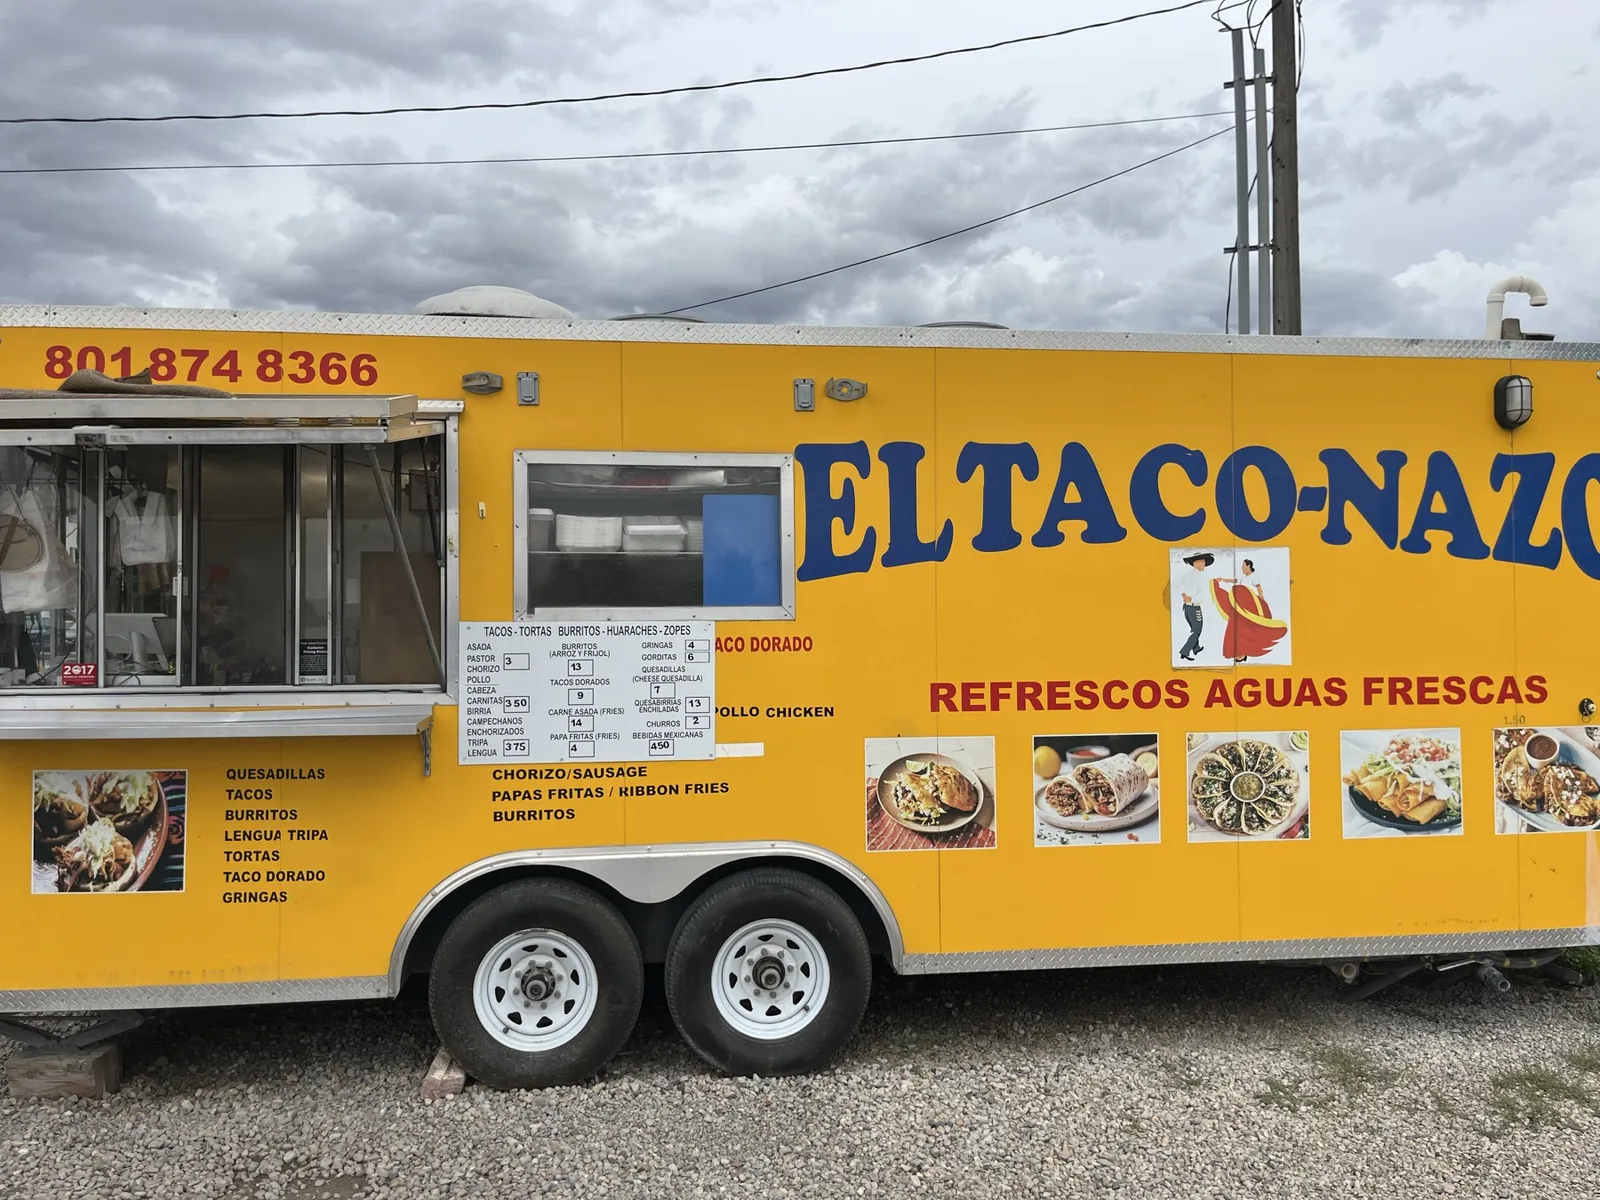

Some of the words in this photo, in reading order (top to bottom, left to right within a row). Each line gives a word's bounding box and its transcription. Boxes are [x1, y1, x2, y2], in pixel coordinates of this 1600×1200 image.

[44, 345, 131, 379] 801
[150, 347, 242, 382] 874
[256, 349, 378, 386] 8366
[484, 626, 513, 637] TACOS
[520, 626, 552, 637] TORTAS
[558, 626, 601, 637] BURRITOS
[606, 625, 658, 636] HUARACHES
[663, 625, 691, 636] ZOPES
[466, 643, 492, 651] ASADA
[561, 642, 598, 650] BURRITOS
[641, 641, 673, 649] GRINGAS
[688, 641, 695, 649] 4
[715, 637, 745, 652] ACO
[750, 636, 813, 652] DORADO
[549, 650, 577, 658] (ARROZ
[583, 650, 611, 658] FRIJOL)
[641, 653, 677, 661] GORDITAS
[687, 653, 694, 661] 6
[466, 654, 496, 663] PASTOR
[505, 657, 512, 665] 3
[63, 665, 95, 675] 2017
[466, 665, 500, 673] CHORIZO
[570, 663, 582, 671] 13
[466, 676, 491, 684] POLLO
[575, 678, 610, 686] DORADOS
[632, 675, 660, 683] (CHEESE
[661, 675, 703, 683] QUESADILLA)
[466, 686, 496, 694] CABEZA
[654, 685, 660, 693] 7
[929, 679, 1190, 712] REFRESCOS
[1203, 677, 1348, 708] AGUAS
[1363, 675, 1548, 706] FRESCAS
[577, 691, 584, 699] 9
[466, 697, 503, 705] CARNITAS
[634, 699, 682, 707] QUESABIRRIAS
[688, 699, 701, 708] 13
[466, 707, 492, 715] BIRRIA
[548, 708, 573, 716] CARNE
[600, 707, 625, 716] (FRIES)
[765, 707, 834, 717] CHICKEN
[466, 717, 523, 726] CAMPECHANOS
[570, 719, 582, 727] 14
[646, 720, 681, 728] CHURROS
[692, 716, 700, 725] 2
[466, 727, 525, 736] ENCHORIZADOS
[664, 731, 704, 739] MEXICANAS
[595, 732, 620, 741] (FRIES)
[467, 739, 488, 747] TRIPA
[650, 740, 670, 750] 450
[570, 744, 577, 752] 4
[467, 749, 498, 757] LENGUA
[226, 768, 326, 780] QUESADILLAS
[492, 766, 648, 780] CHORIZO/SAUSAGE
[226, 789, 273, 800] TACOS
[492, 789, 543, 801] PAPAS
[548, 787, 604, 799] FRITAS
[619, 785, 679, 797] RIBBON
[685, 782, 730, 794] FRIES
[225, 809, 298, 820] BURRITOS
[493, 808, 576, 822] BURRITOS
[224, 830, 282, 841] LENGUA
[287, 830, 328, 840] TRIPA
[224, 850, 280, 861] TORTAS
[223, 871, 261, 882] TACO
[266, 870, 325, 882] DORADO
[222, 891, 288, 903] GRINGAS
